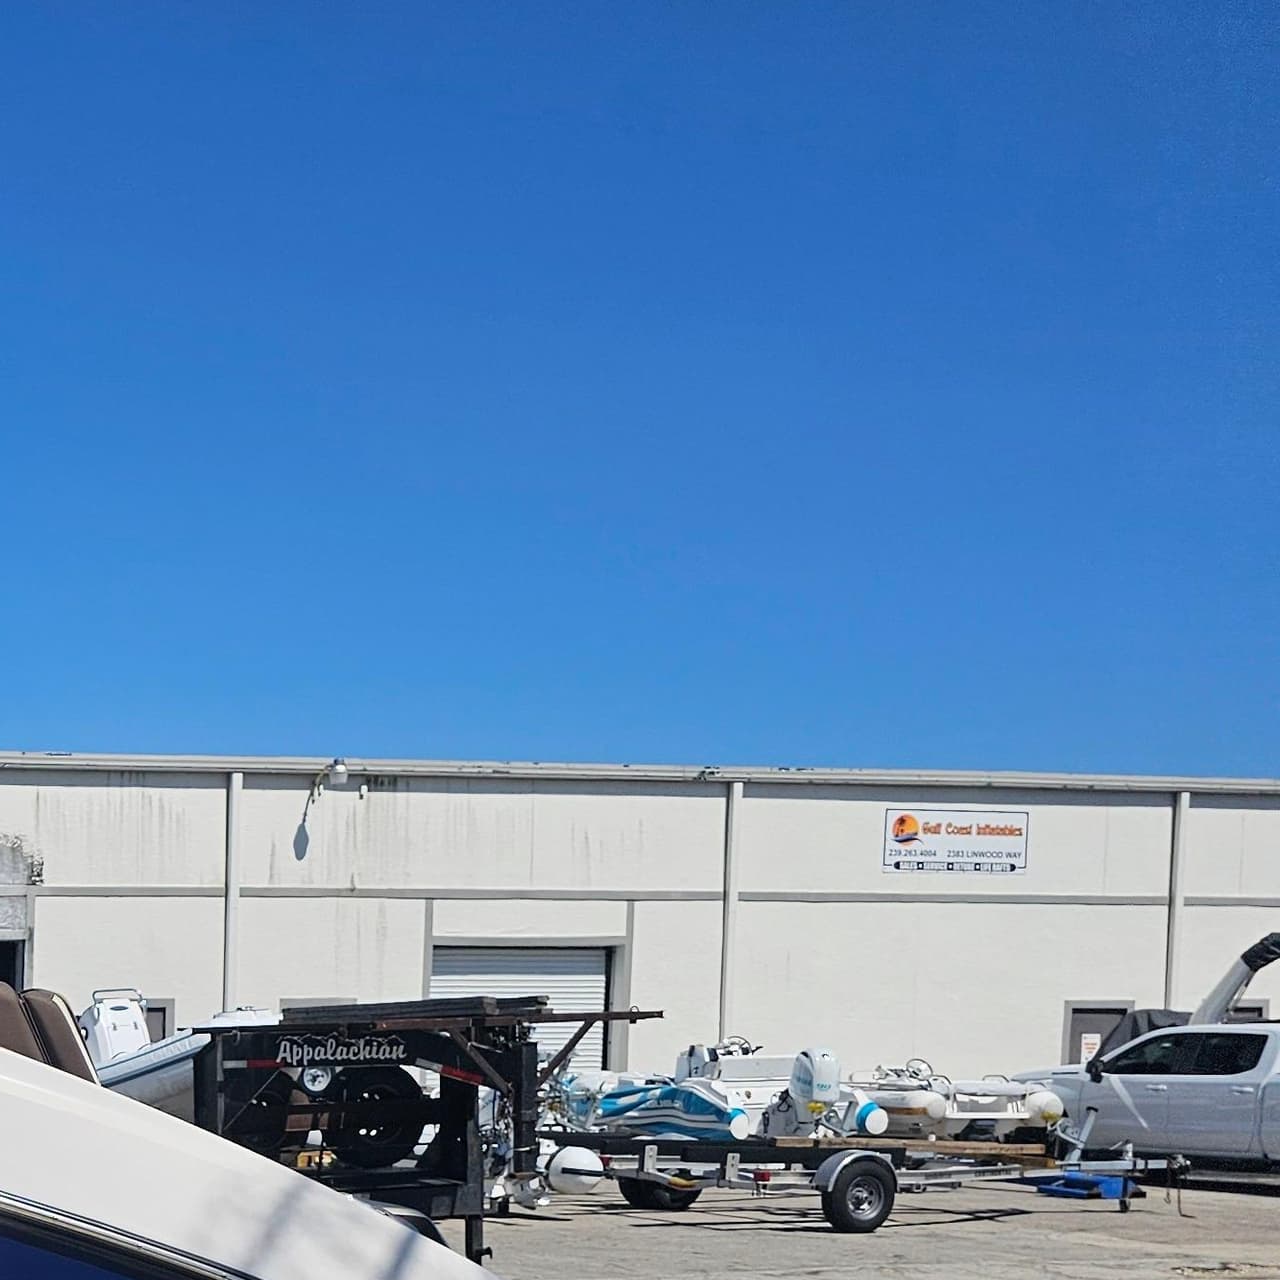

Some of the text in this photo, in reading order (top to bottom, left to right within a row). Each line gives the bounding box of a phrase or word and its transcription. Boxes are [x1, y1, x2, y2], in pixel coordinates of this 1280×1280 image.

[946, 822, 972, 835] Coast
[967, 850, 1003, 859] LINWOOD
[1005, 851, 1022, 860] WAY
[276, 1039, 407, 1066] Appalachian
